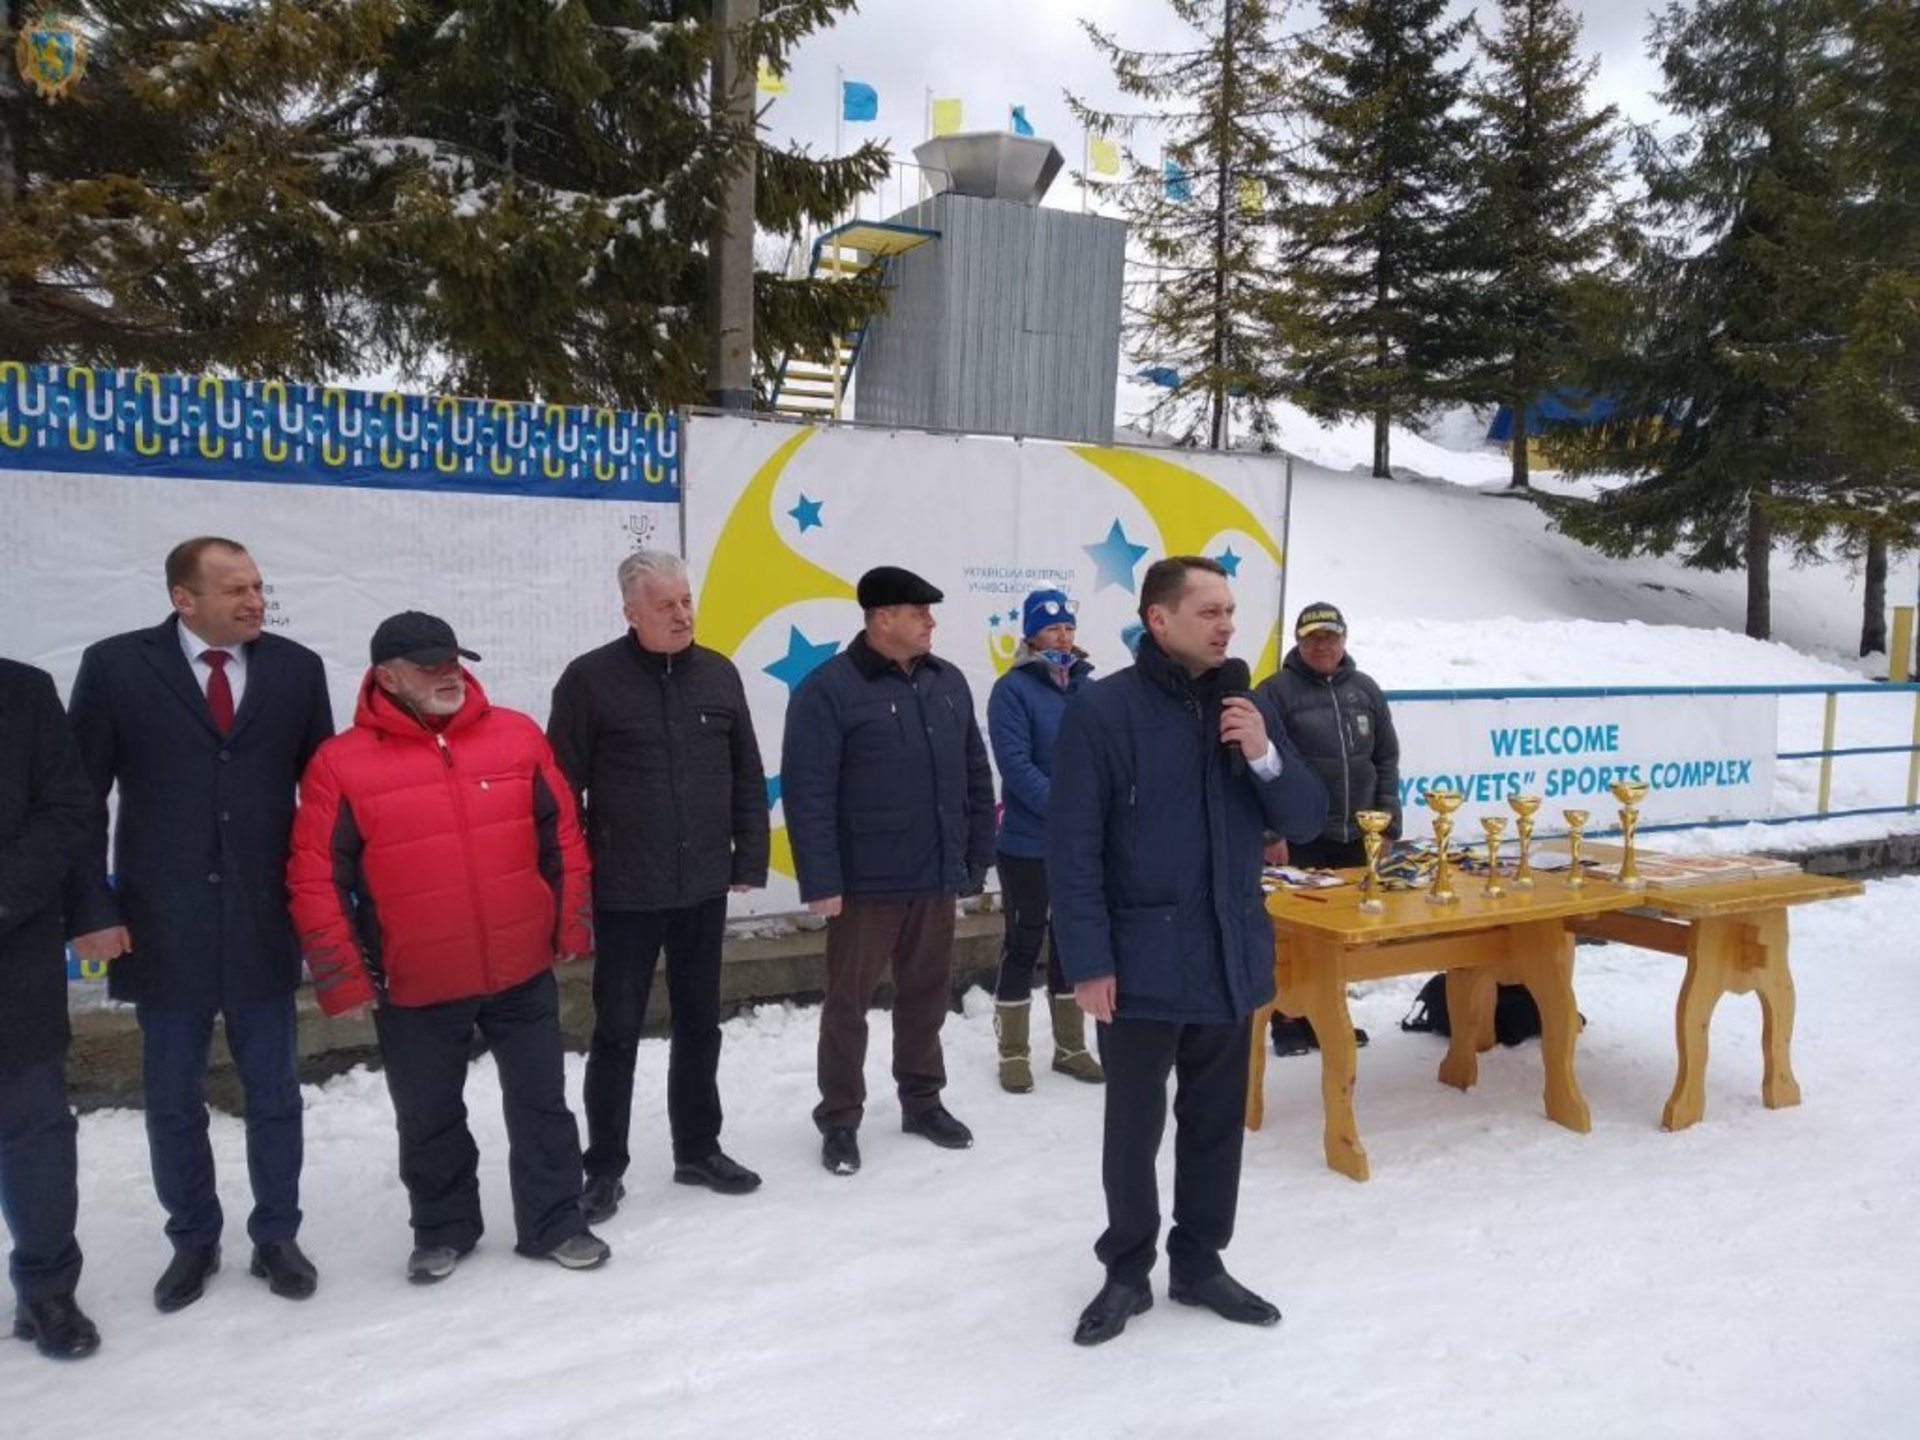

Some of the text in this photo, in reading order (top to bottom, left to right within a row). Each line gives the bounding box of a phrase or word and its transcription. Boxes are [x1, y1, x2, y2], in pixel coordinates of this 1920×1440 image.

[1490, 724, 1619, 757] WELCOME
[1399, 758, 1753, 807] YSOVETS” SPORTS COMPLEX
